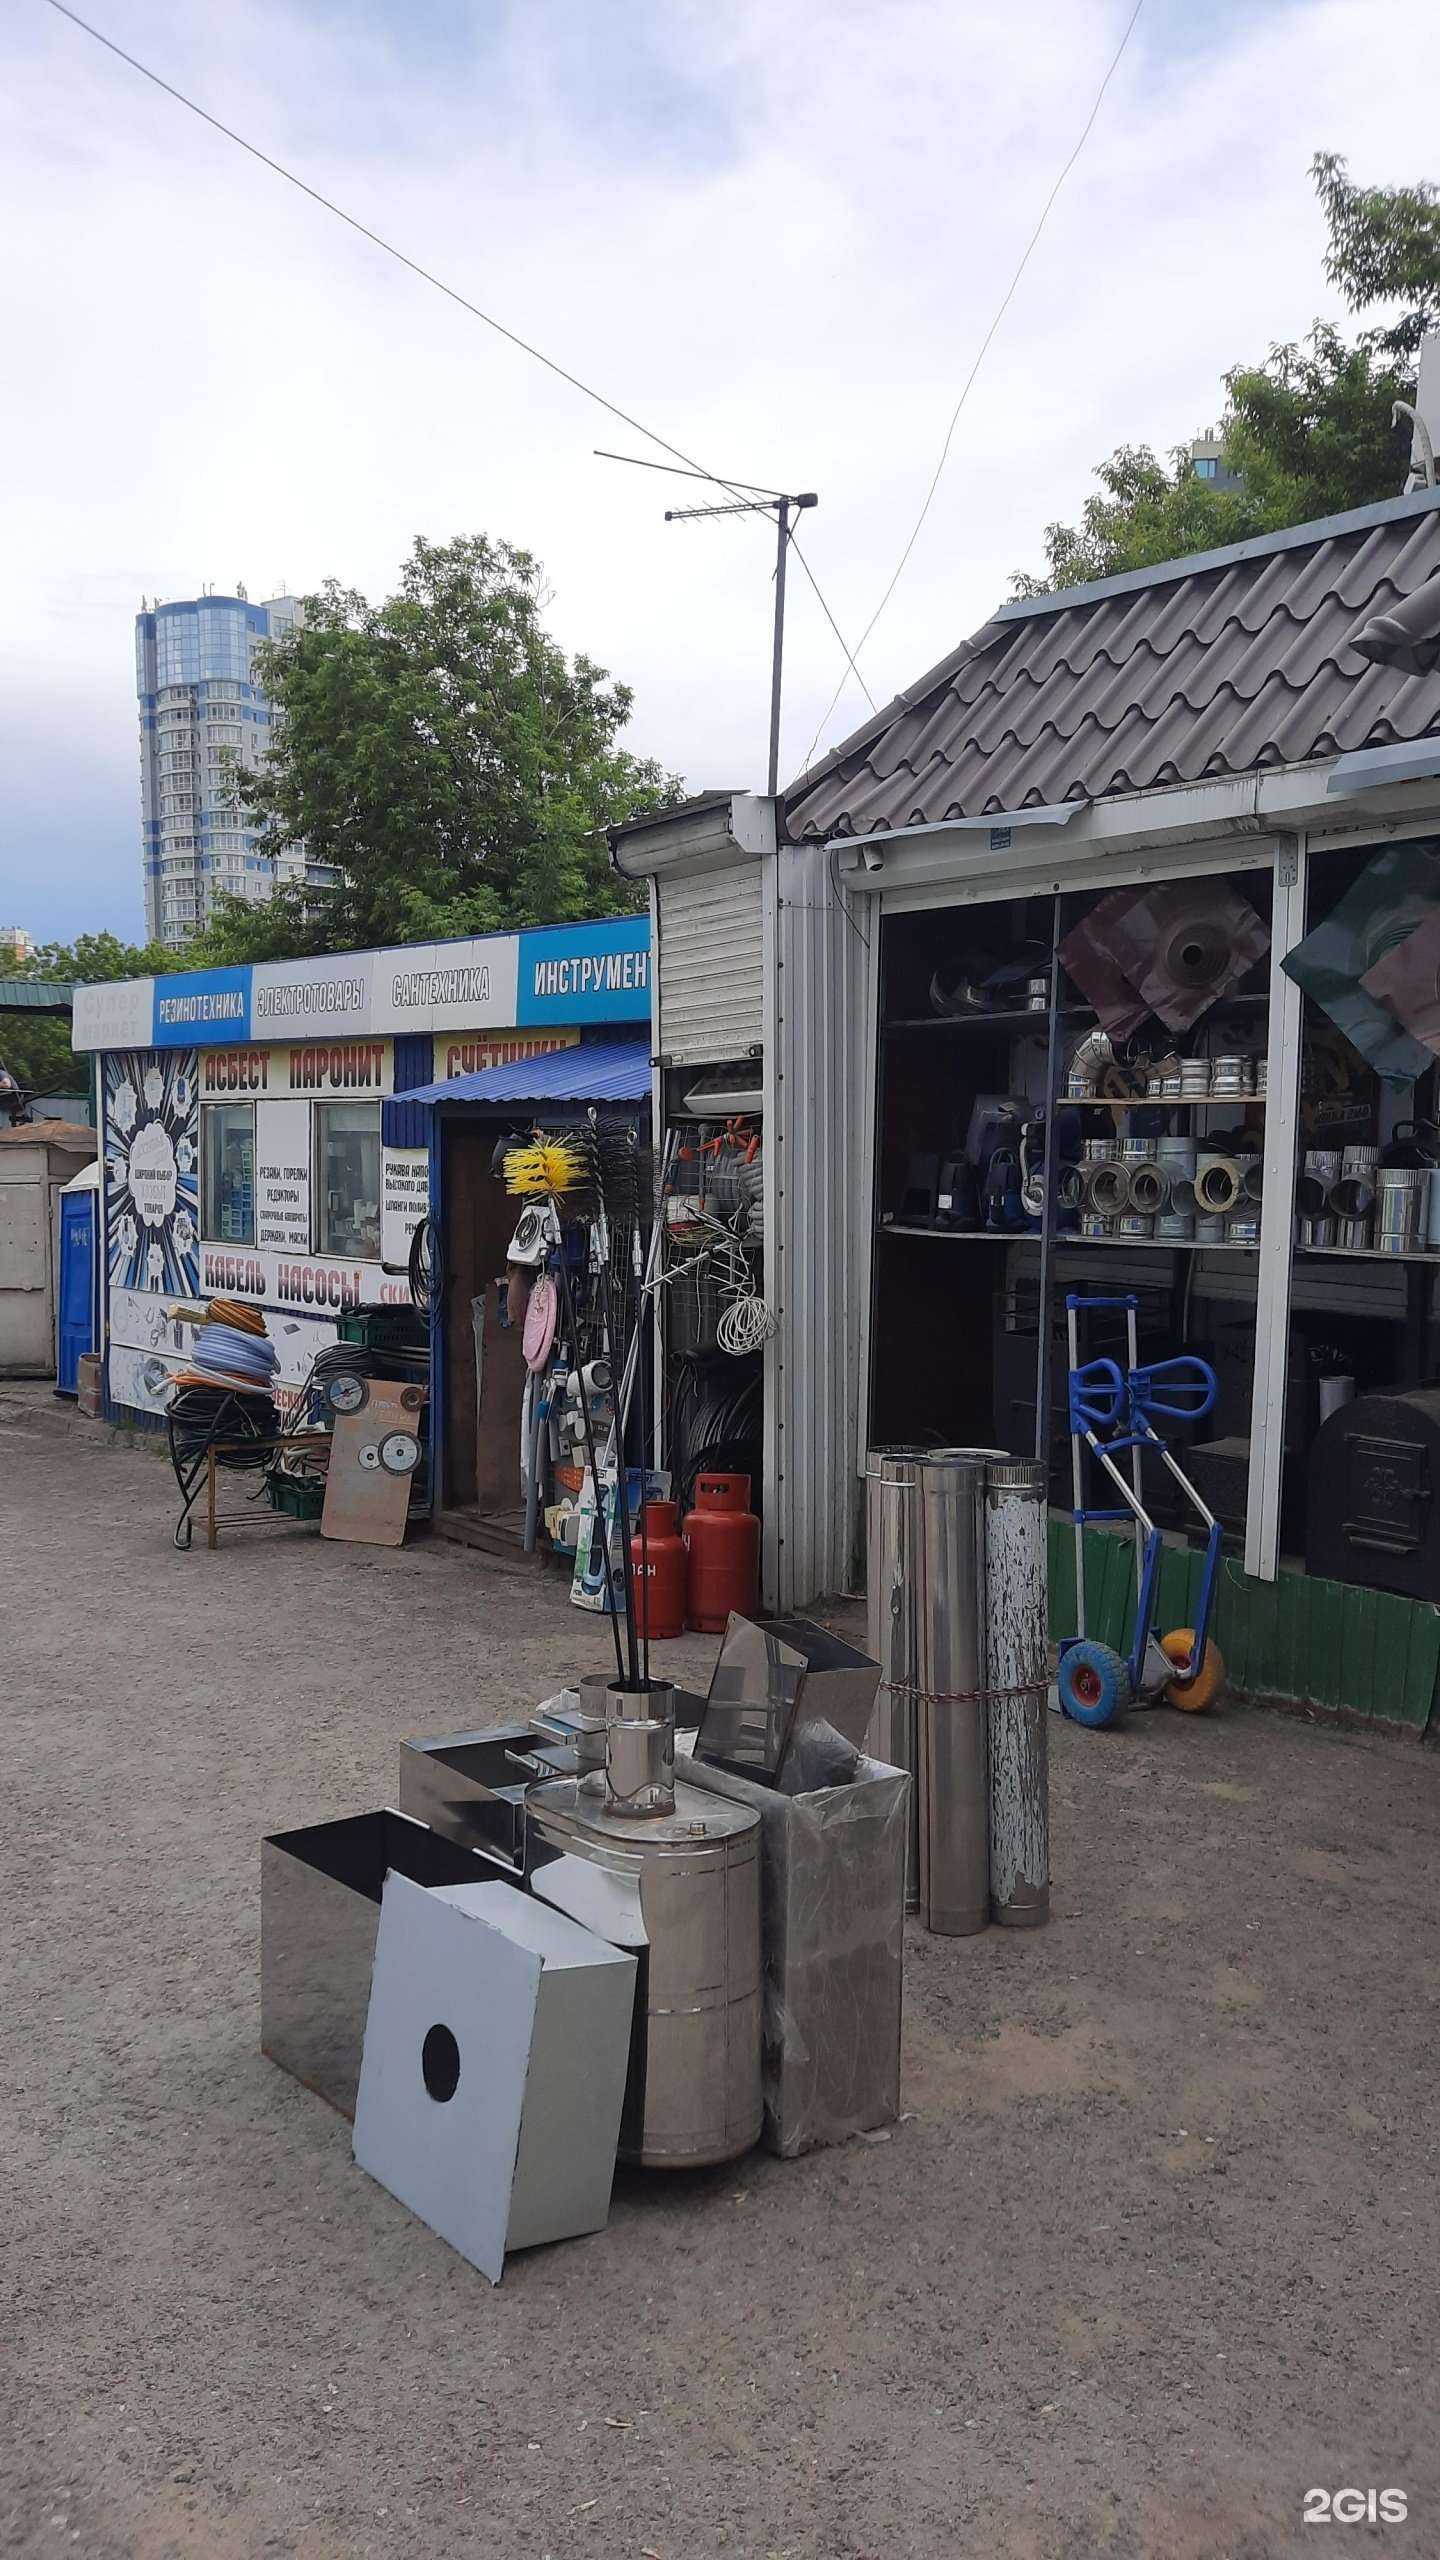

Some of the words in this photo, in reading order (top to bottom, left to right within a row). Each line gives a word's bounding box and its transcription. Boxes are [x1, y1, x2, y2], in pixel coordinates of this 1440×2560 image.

[257, 978, 364, 1017] ЭЛЕКТРОТОВАРЫ
[392, 966, 490, 1008] САНТЕХНИКА
[160, 992, 243, 1023] РЕЗИНОТЕХНИКА
[205, 1051, 271, 1092] АСБЕСТ
[289, 1044, 385, 1089] ПАРОНИТ
[385, 1163, 410, 1177] РУКАВА
[267, 1189, 300, 1203] РЕДУКТОРЫ
[204, 1254, 266, 1295] КАБЕЛЬ
[277, 1263, 360, 1308] НАСОСЫ
